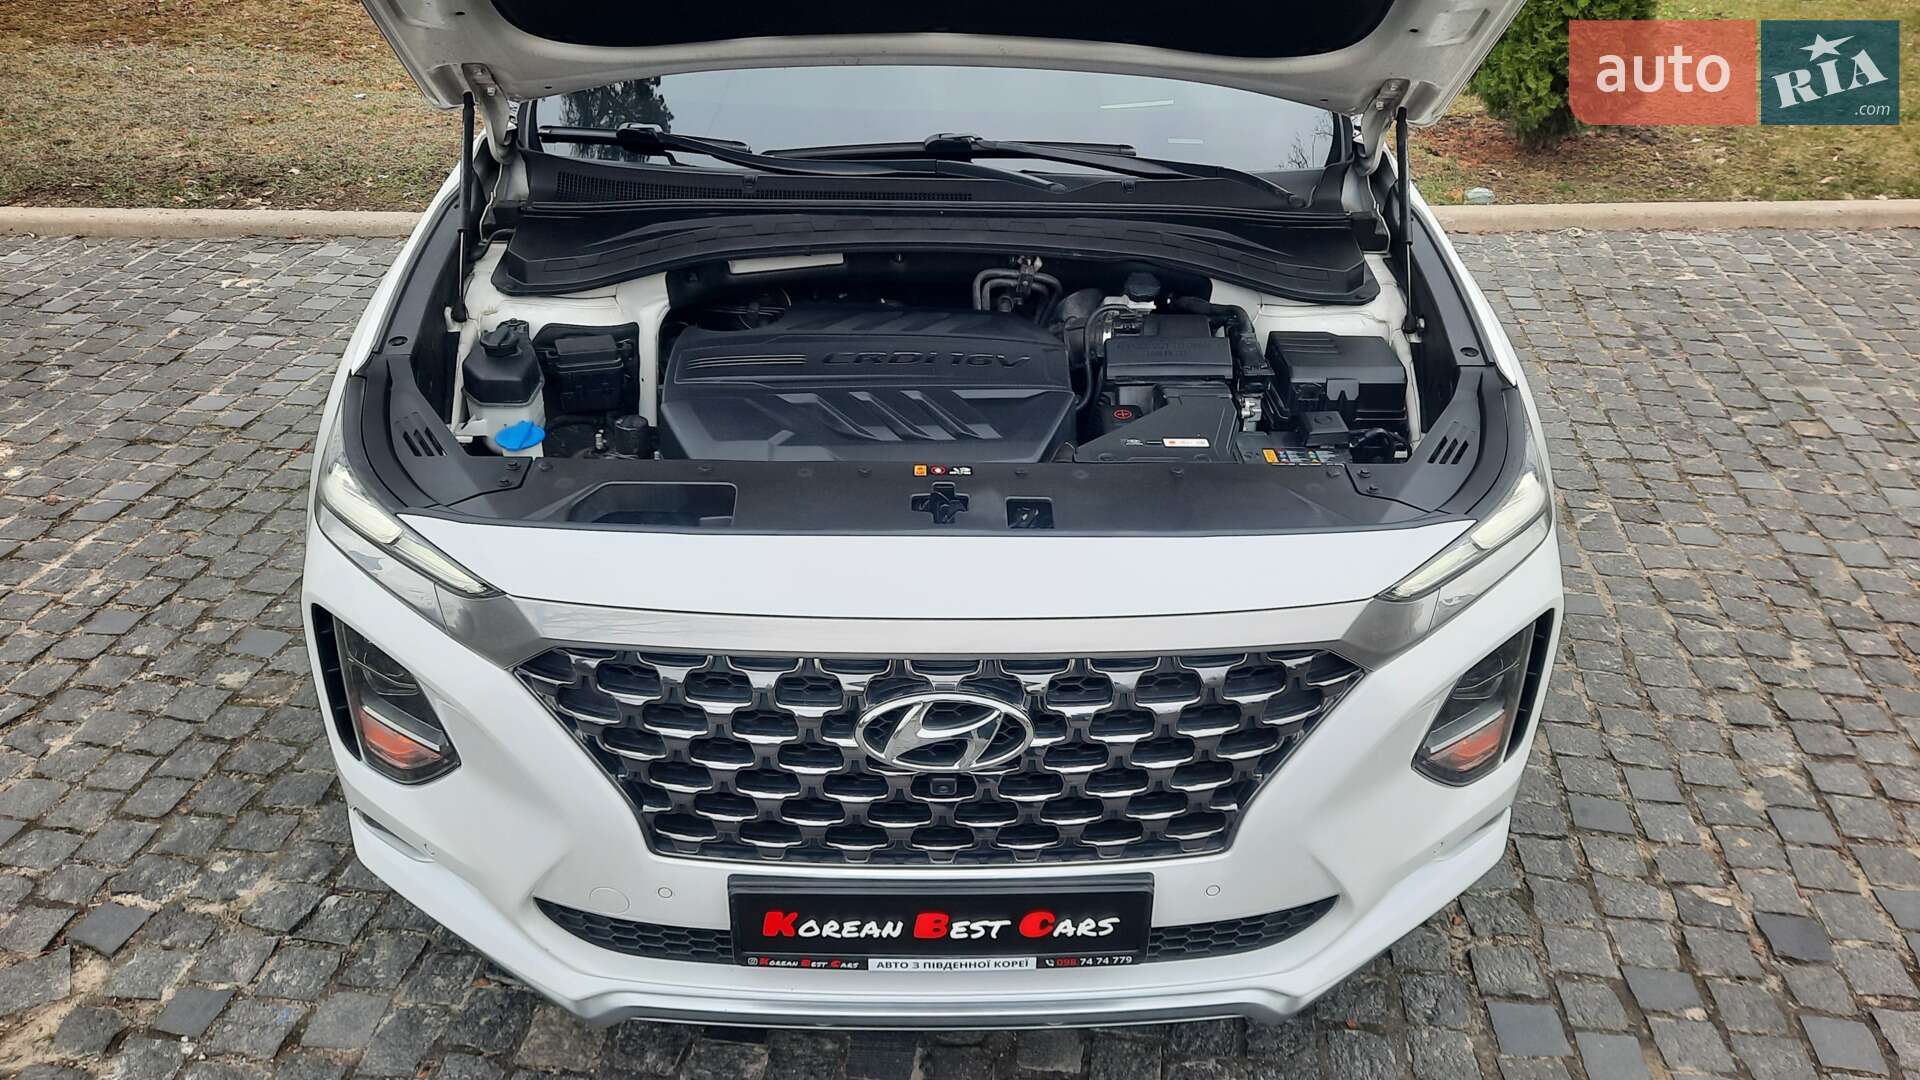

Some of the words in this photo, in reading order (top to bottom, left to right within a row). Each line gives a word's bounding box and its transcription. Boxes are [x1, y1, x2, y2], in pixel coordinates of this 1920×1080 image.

[949, 352, 1030, 368] 16V
[762, 911, 904, 938] KOREAN
[913, 912, 1011, 940] BEST
[1019, 911, 1121, 938] CARS
[876, 960, 909, 970] АВТО
[923, 959, 991, 970] ПІВДЕННОЇ
[993, 958, 1030, 969] КОРЕЇ
[1079, 957, 1094, 966] 74
[1096, 956, 1110, 965] 74
[1112, 955, 1133, 965] 779
